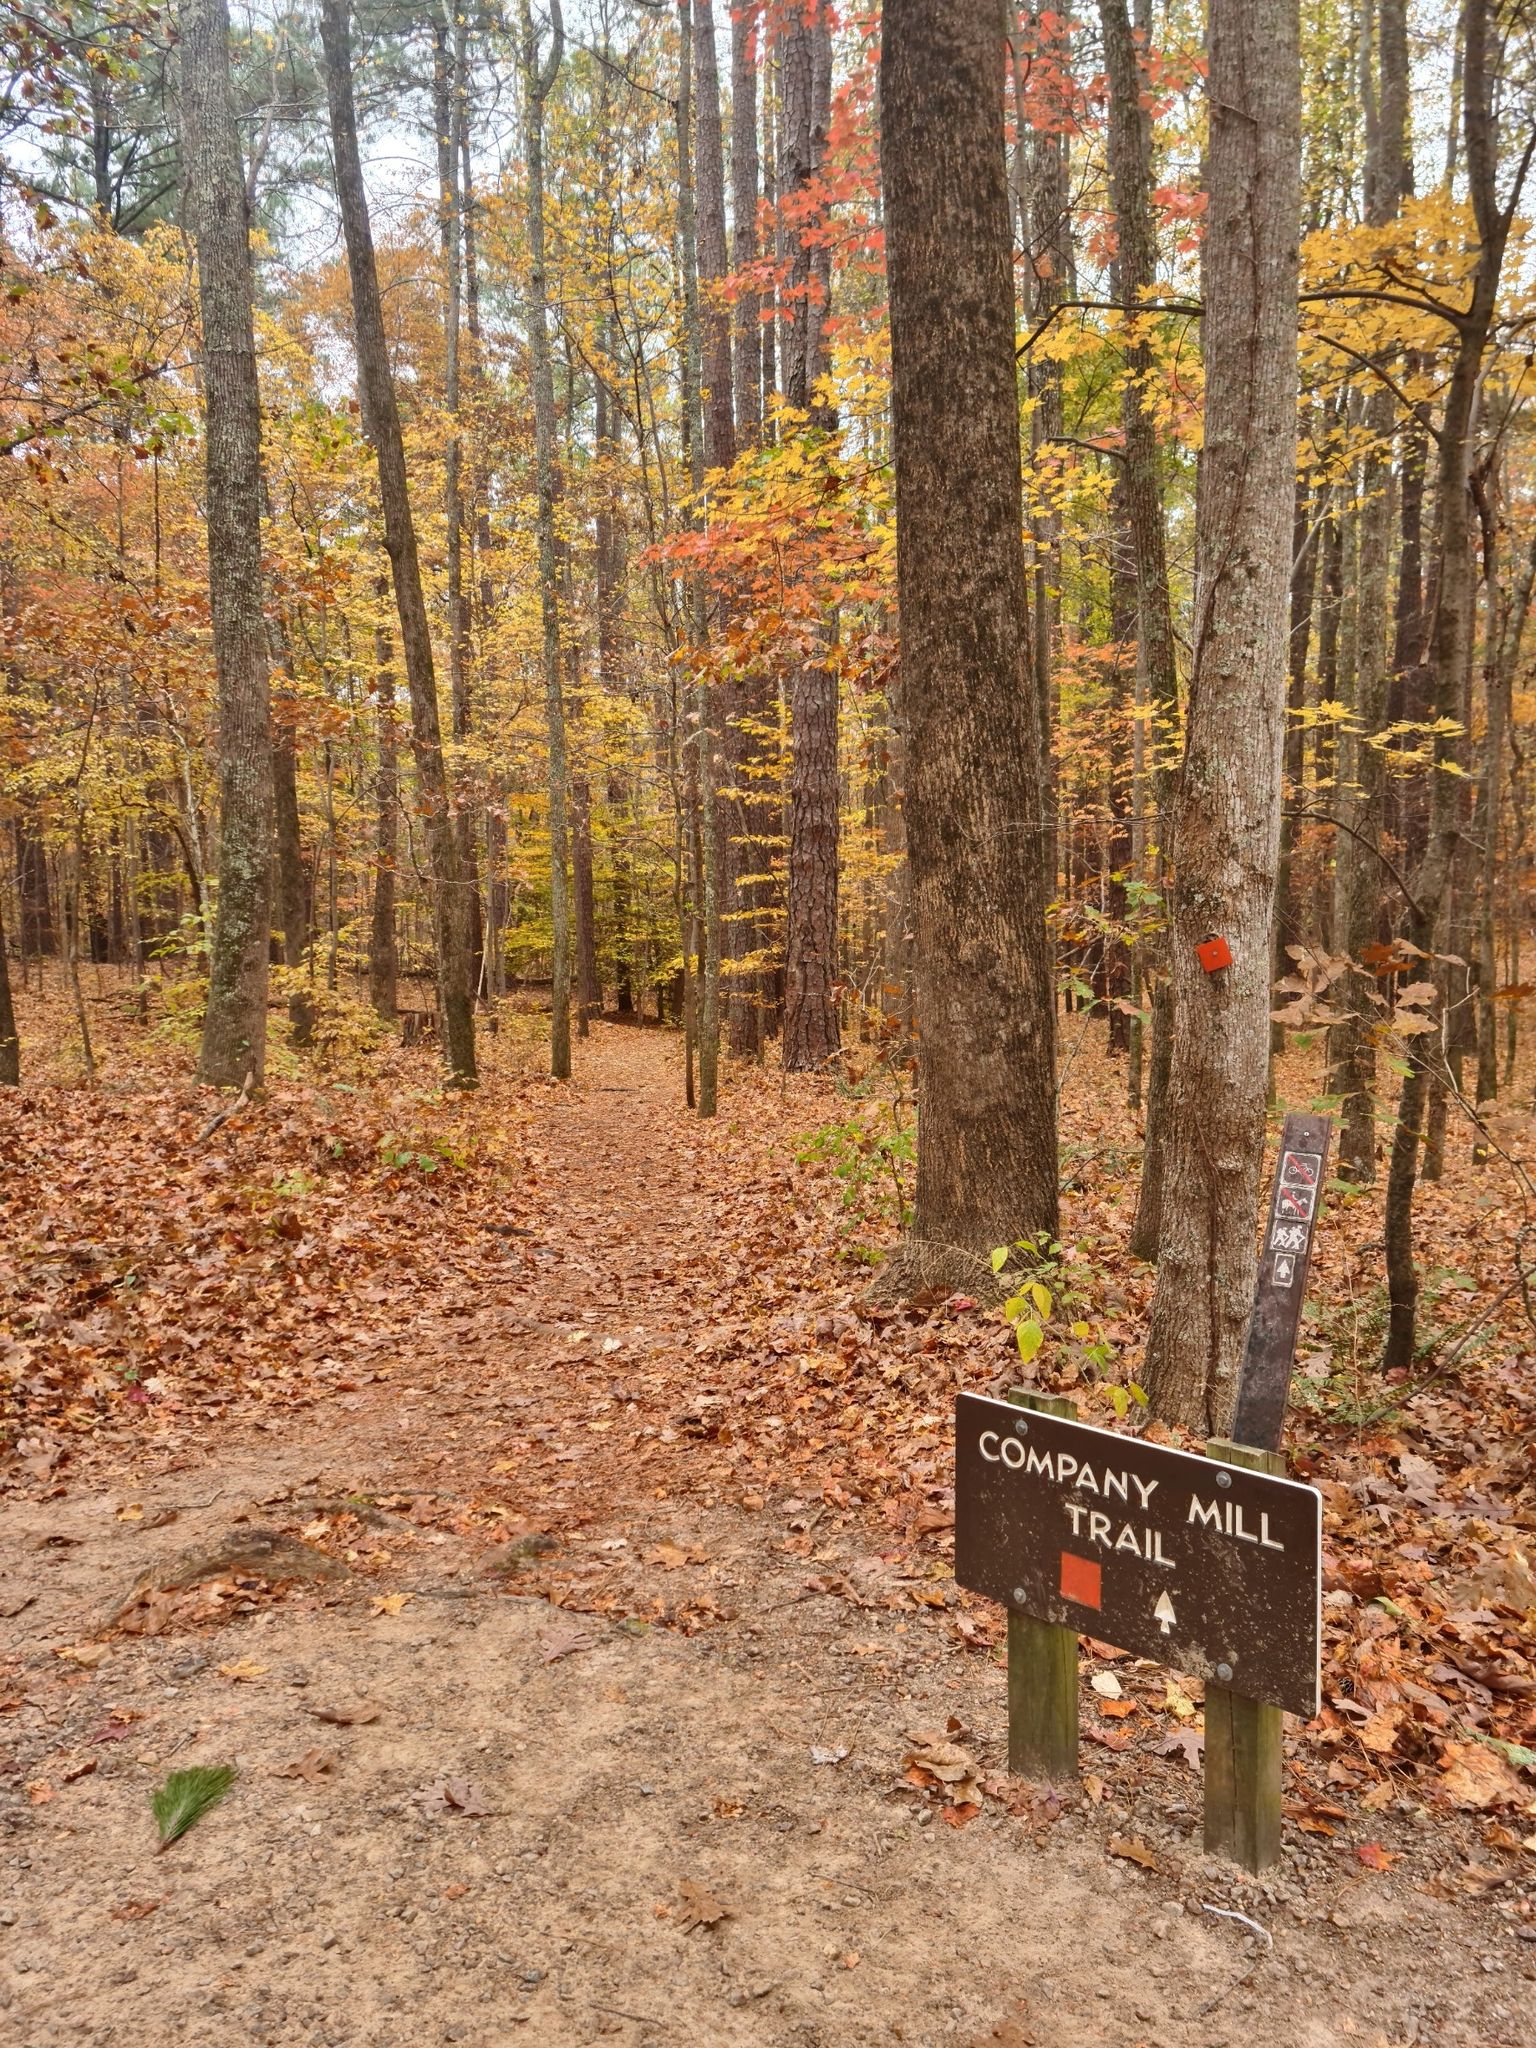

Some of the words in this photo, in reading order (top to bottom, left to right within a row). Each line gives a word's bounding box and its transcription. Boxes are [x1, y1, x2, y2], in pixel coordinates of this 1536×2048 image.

[978, 1431, 1159, 1509] COMPANY
[1187, 1493, 1285, 1552] MILL
[1064, 1502, 1176, 1568] TRAIL
